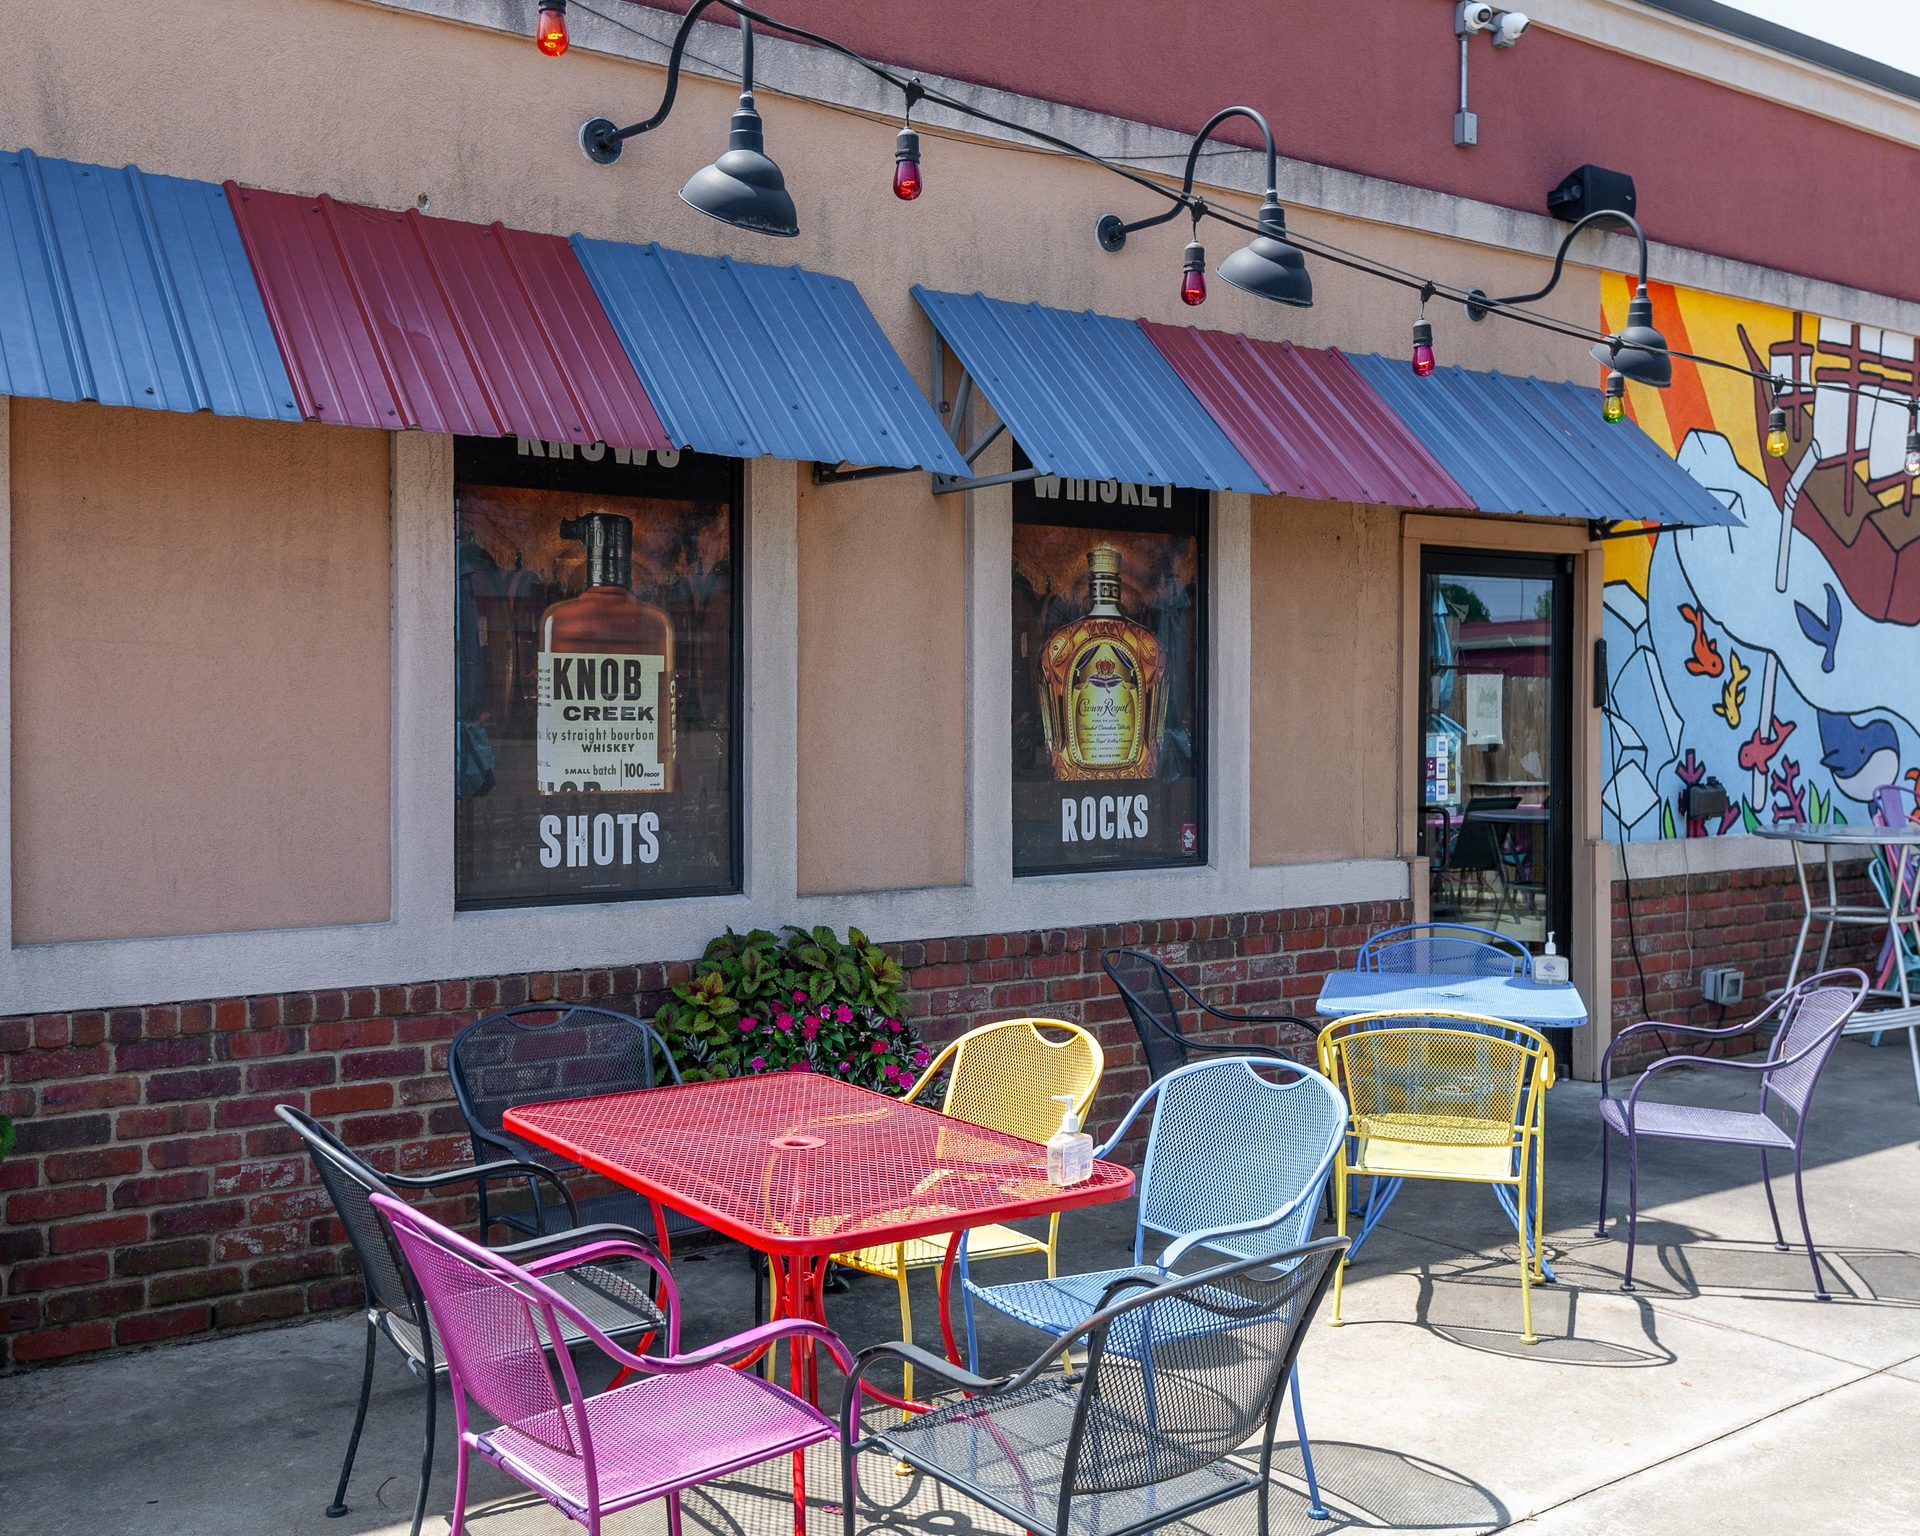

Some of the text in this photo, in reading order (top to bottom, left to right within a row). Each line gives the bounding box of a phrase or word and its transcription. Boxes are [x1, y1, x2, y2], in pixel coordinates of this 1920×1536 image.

[553, 657, 642, 702] KNOB
[563, 706, 655, 721] CREEK
[1078, 698, 1130, 717] Crown Royal
[561, 728, 607, 744] straight
[610, 728, 655, 741] bourbon
[581, 743, 636, 753] WHISKEY
[593, 764, 617, 776] batch
[624, 762, 645, 778] 100
[1062, 794, 1149, 843] ROCKS
[539, 811, 660, 869] SHOTS
